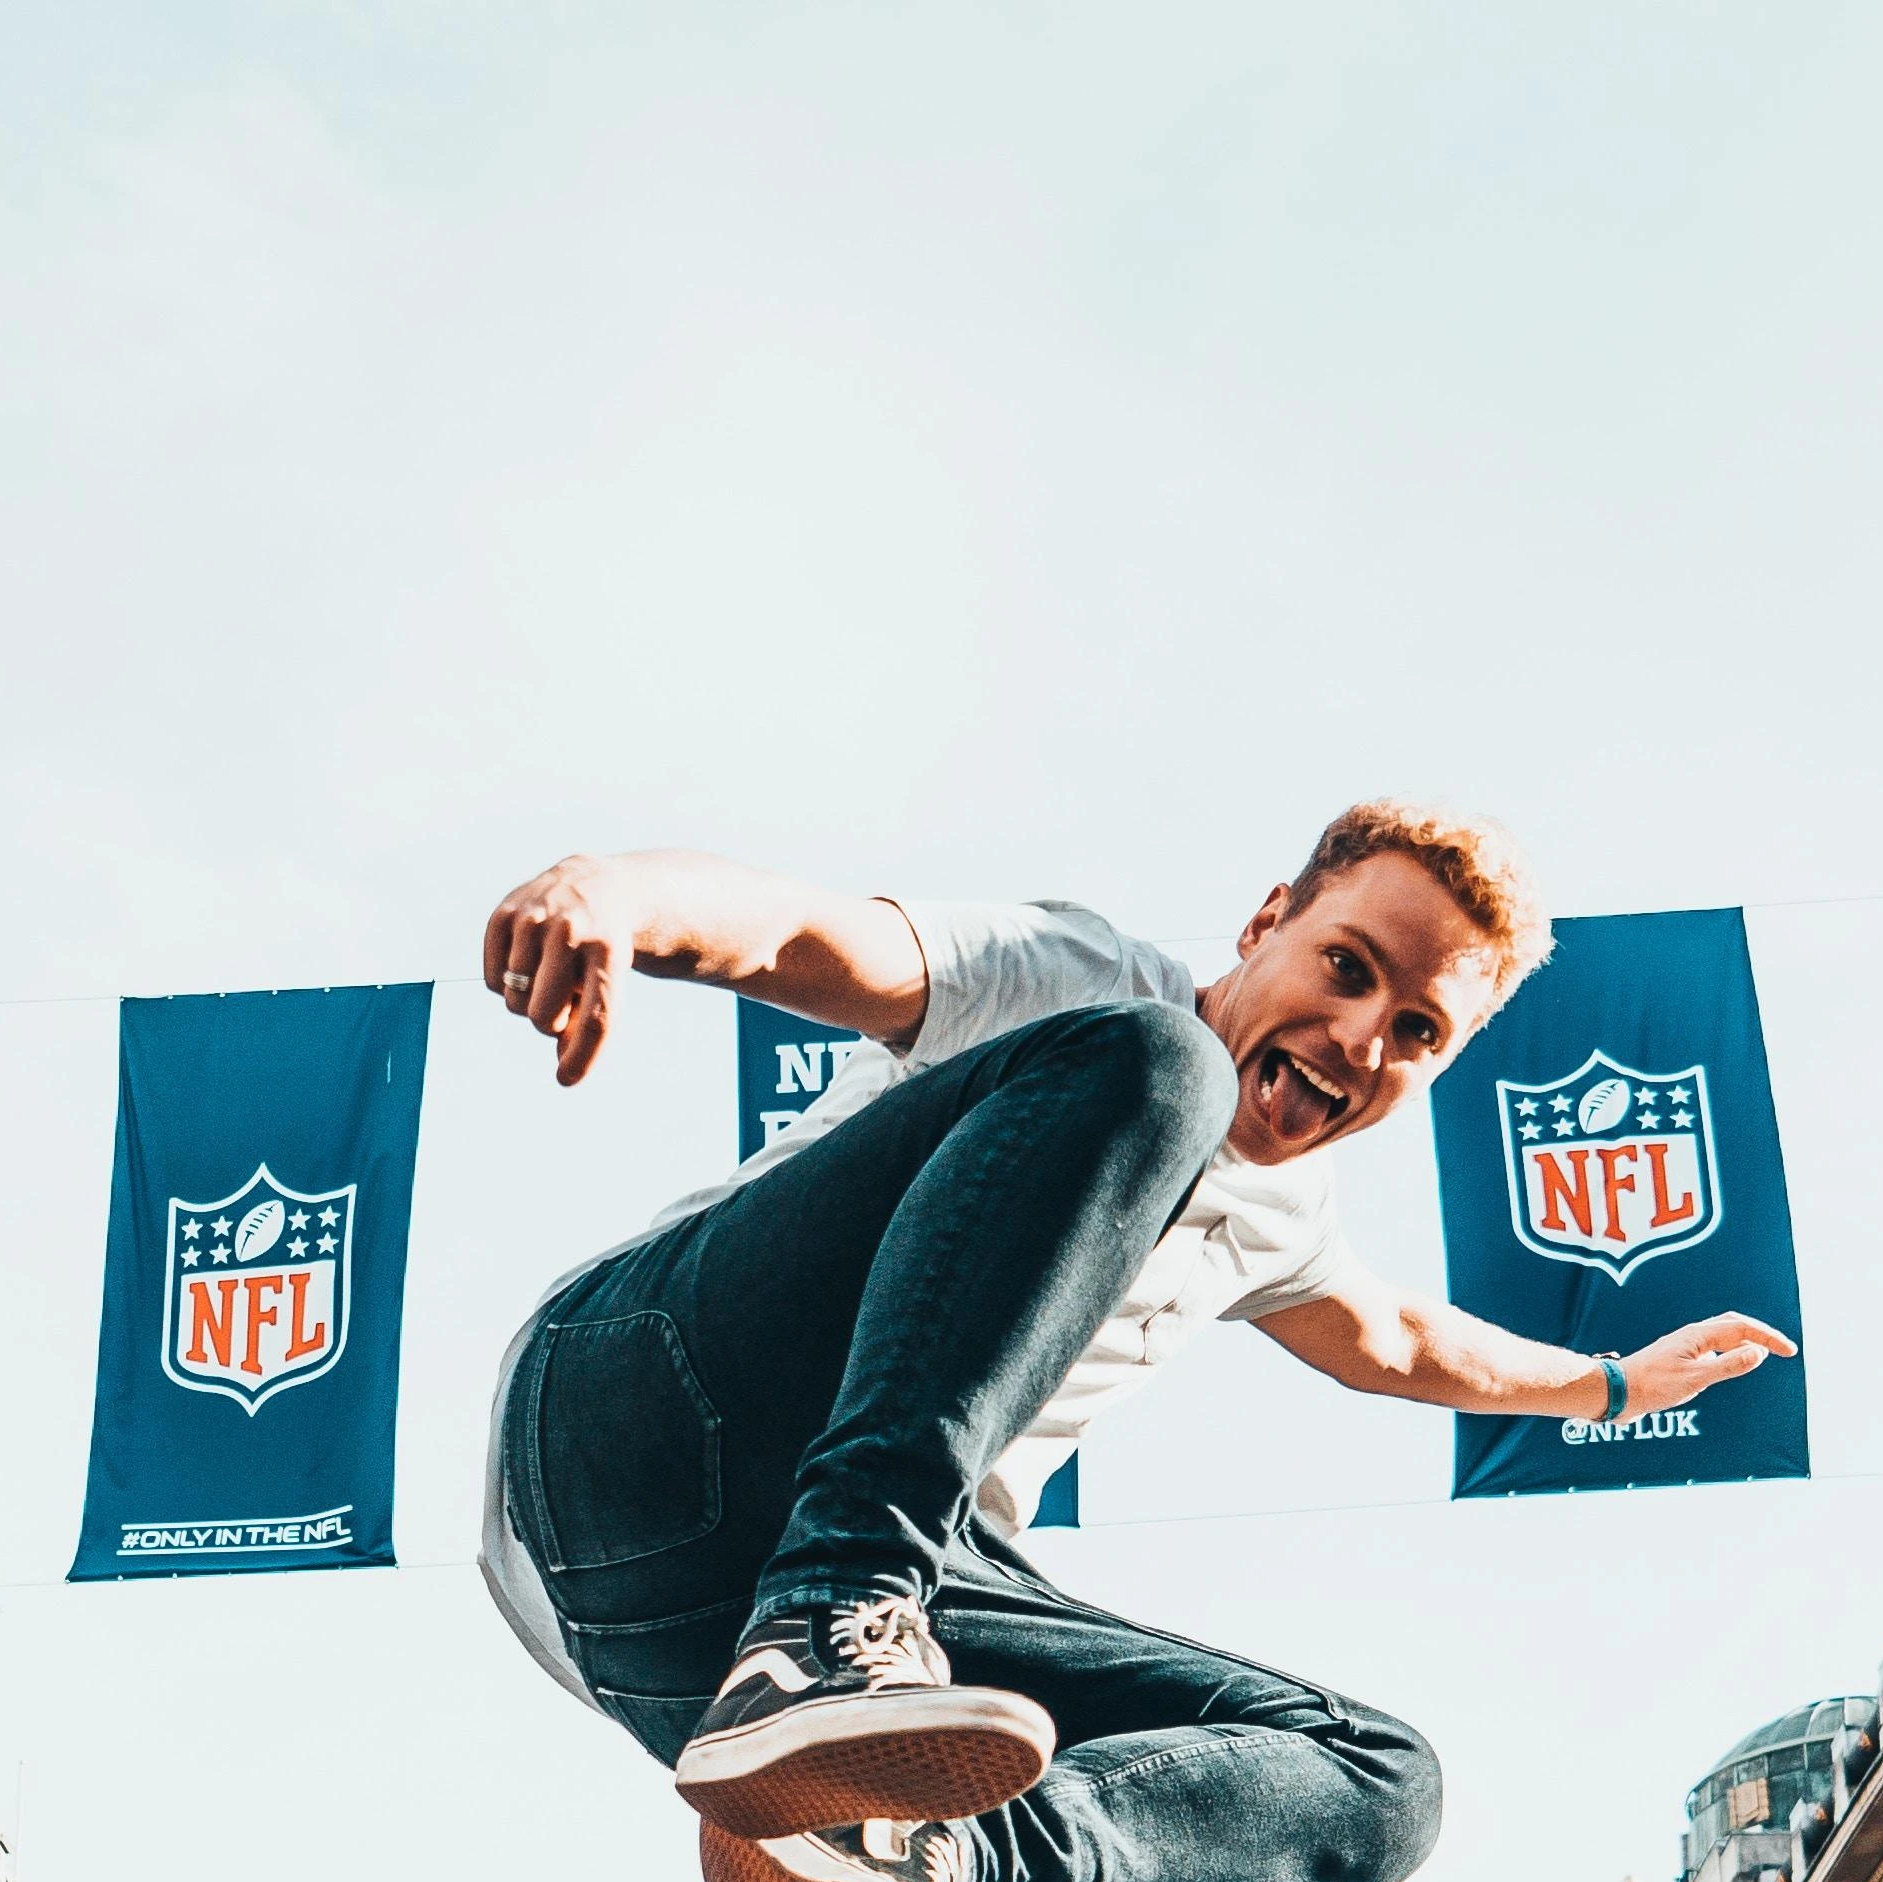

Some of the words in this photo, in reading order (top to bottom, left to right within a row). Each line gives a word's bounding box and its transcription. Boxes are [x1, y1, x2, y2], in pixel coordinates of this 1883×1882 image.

[775, 1041, 860, 1094] NF
[1534, 1143, 1695, 1242] NFL
[185, 1271, 326, 1376] NFL
[1561, 1409, 1701, 1445] @NFLUK
[121, 1528, 213, 1549] #ONLY
[214, 1527, 243, 1547] IN
[245, 1524, 302, 1545] THE
[303, 1516, 352, 1543] NFL
